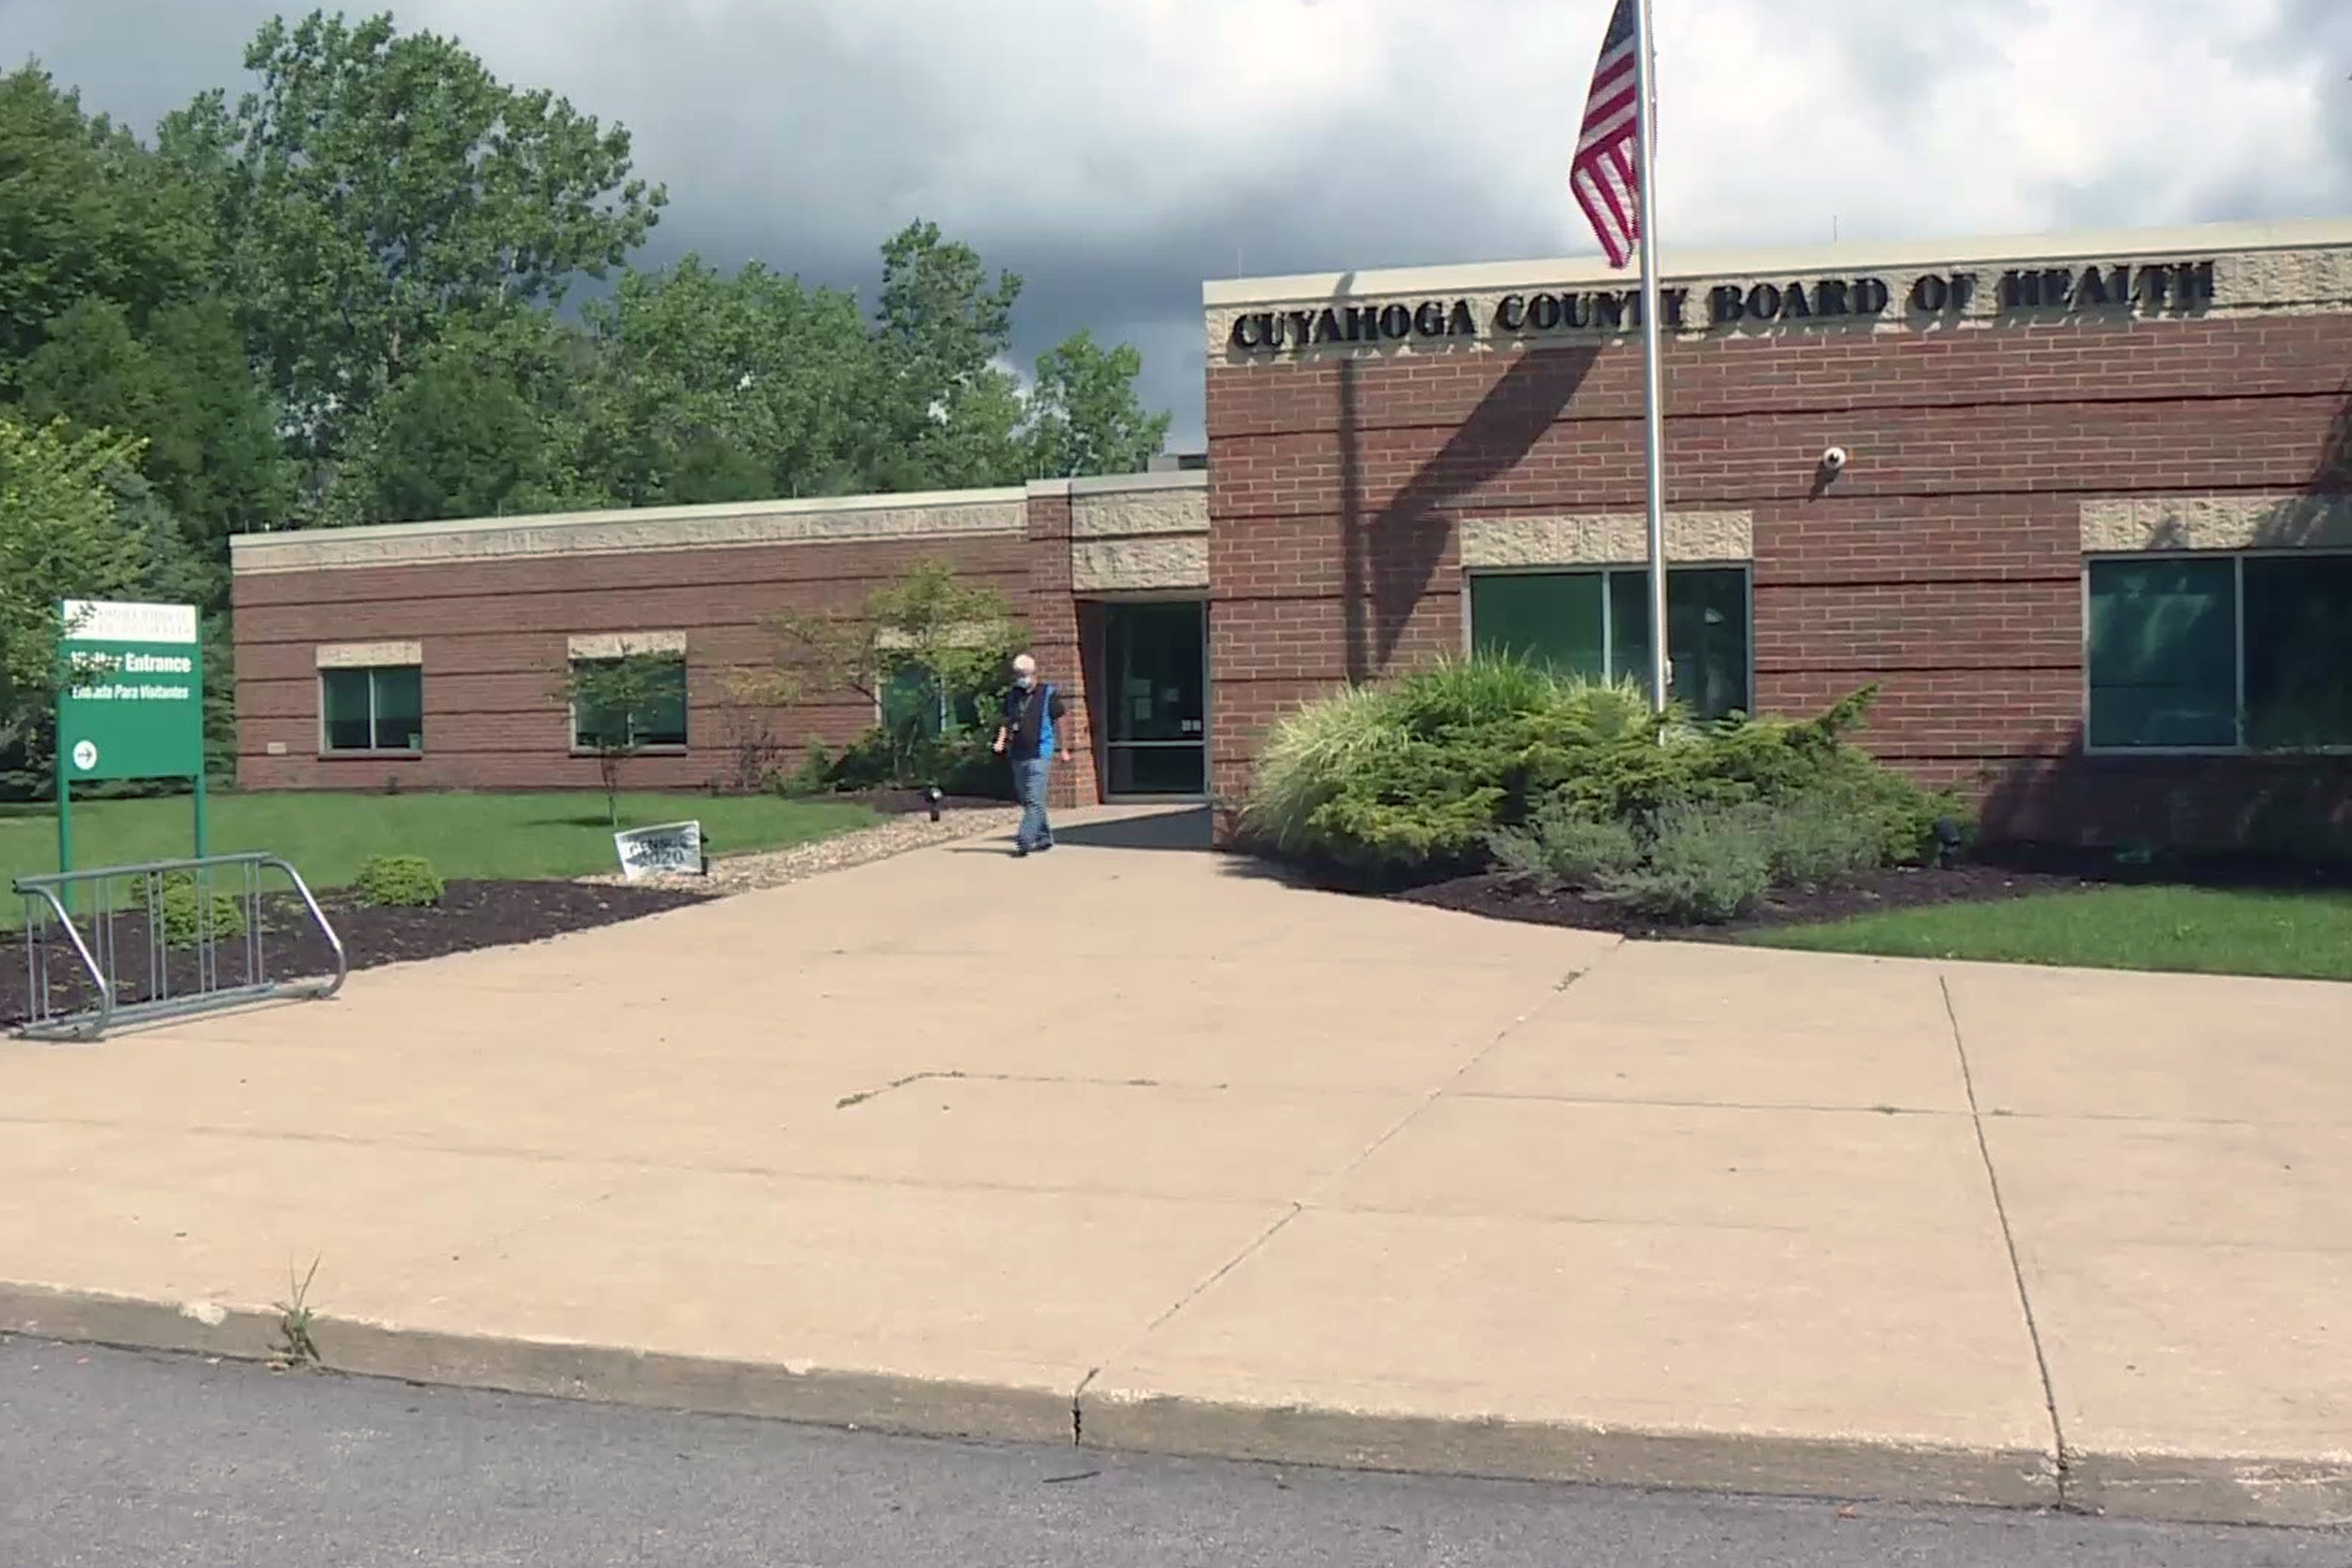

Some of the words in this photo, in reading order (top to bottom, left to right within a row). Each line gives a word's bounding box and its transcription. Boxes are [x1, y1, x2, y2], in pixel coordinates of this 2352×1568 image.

[1232, 298, 1477, 347] CUYAHOGA
[1494, 288, 1689, 330] COUNTY
[1708, 278, 1888, 323] BOARD
[1908, 274, 1976, 311] OF
[1996, 261, 2215, 309] HEALTH
[125, 652, 192, 673] Entrance
[114, 684, 138, 699] Para
